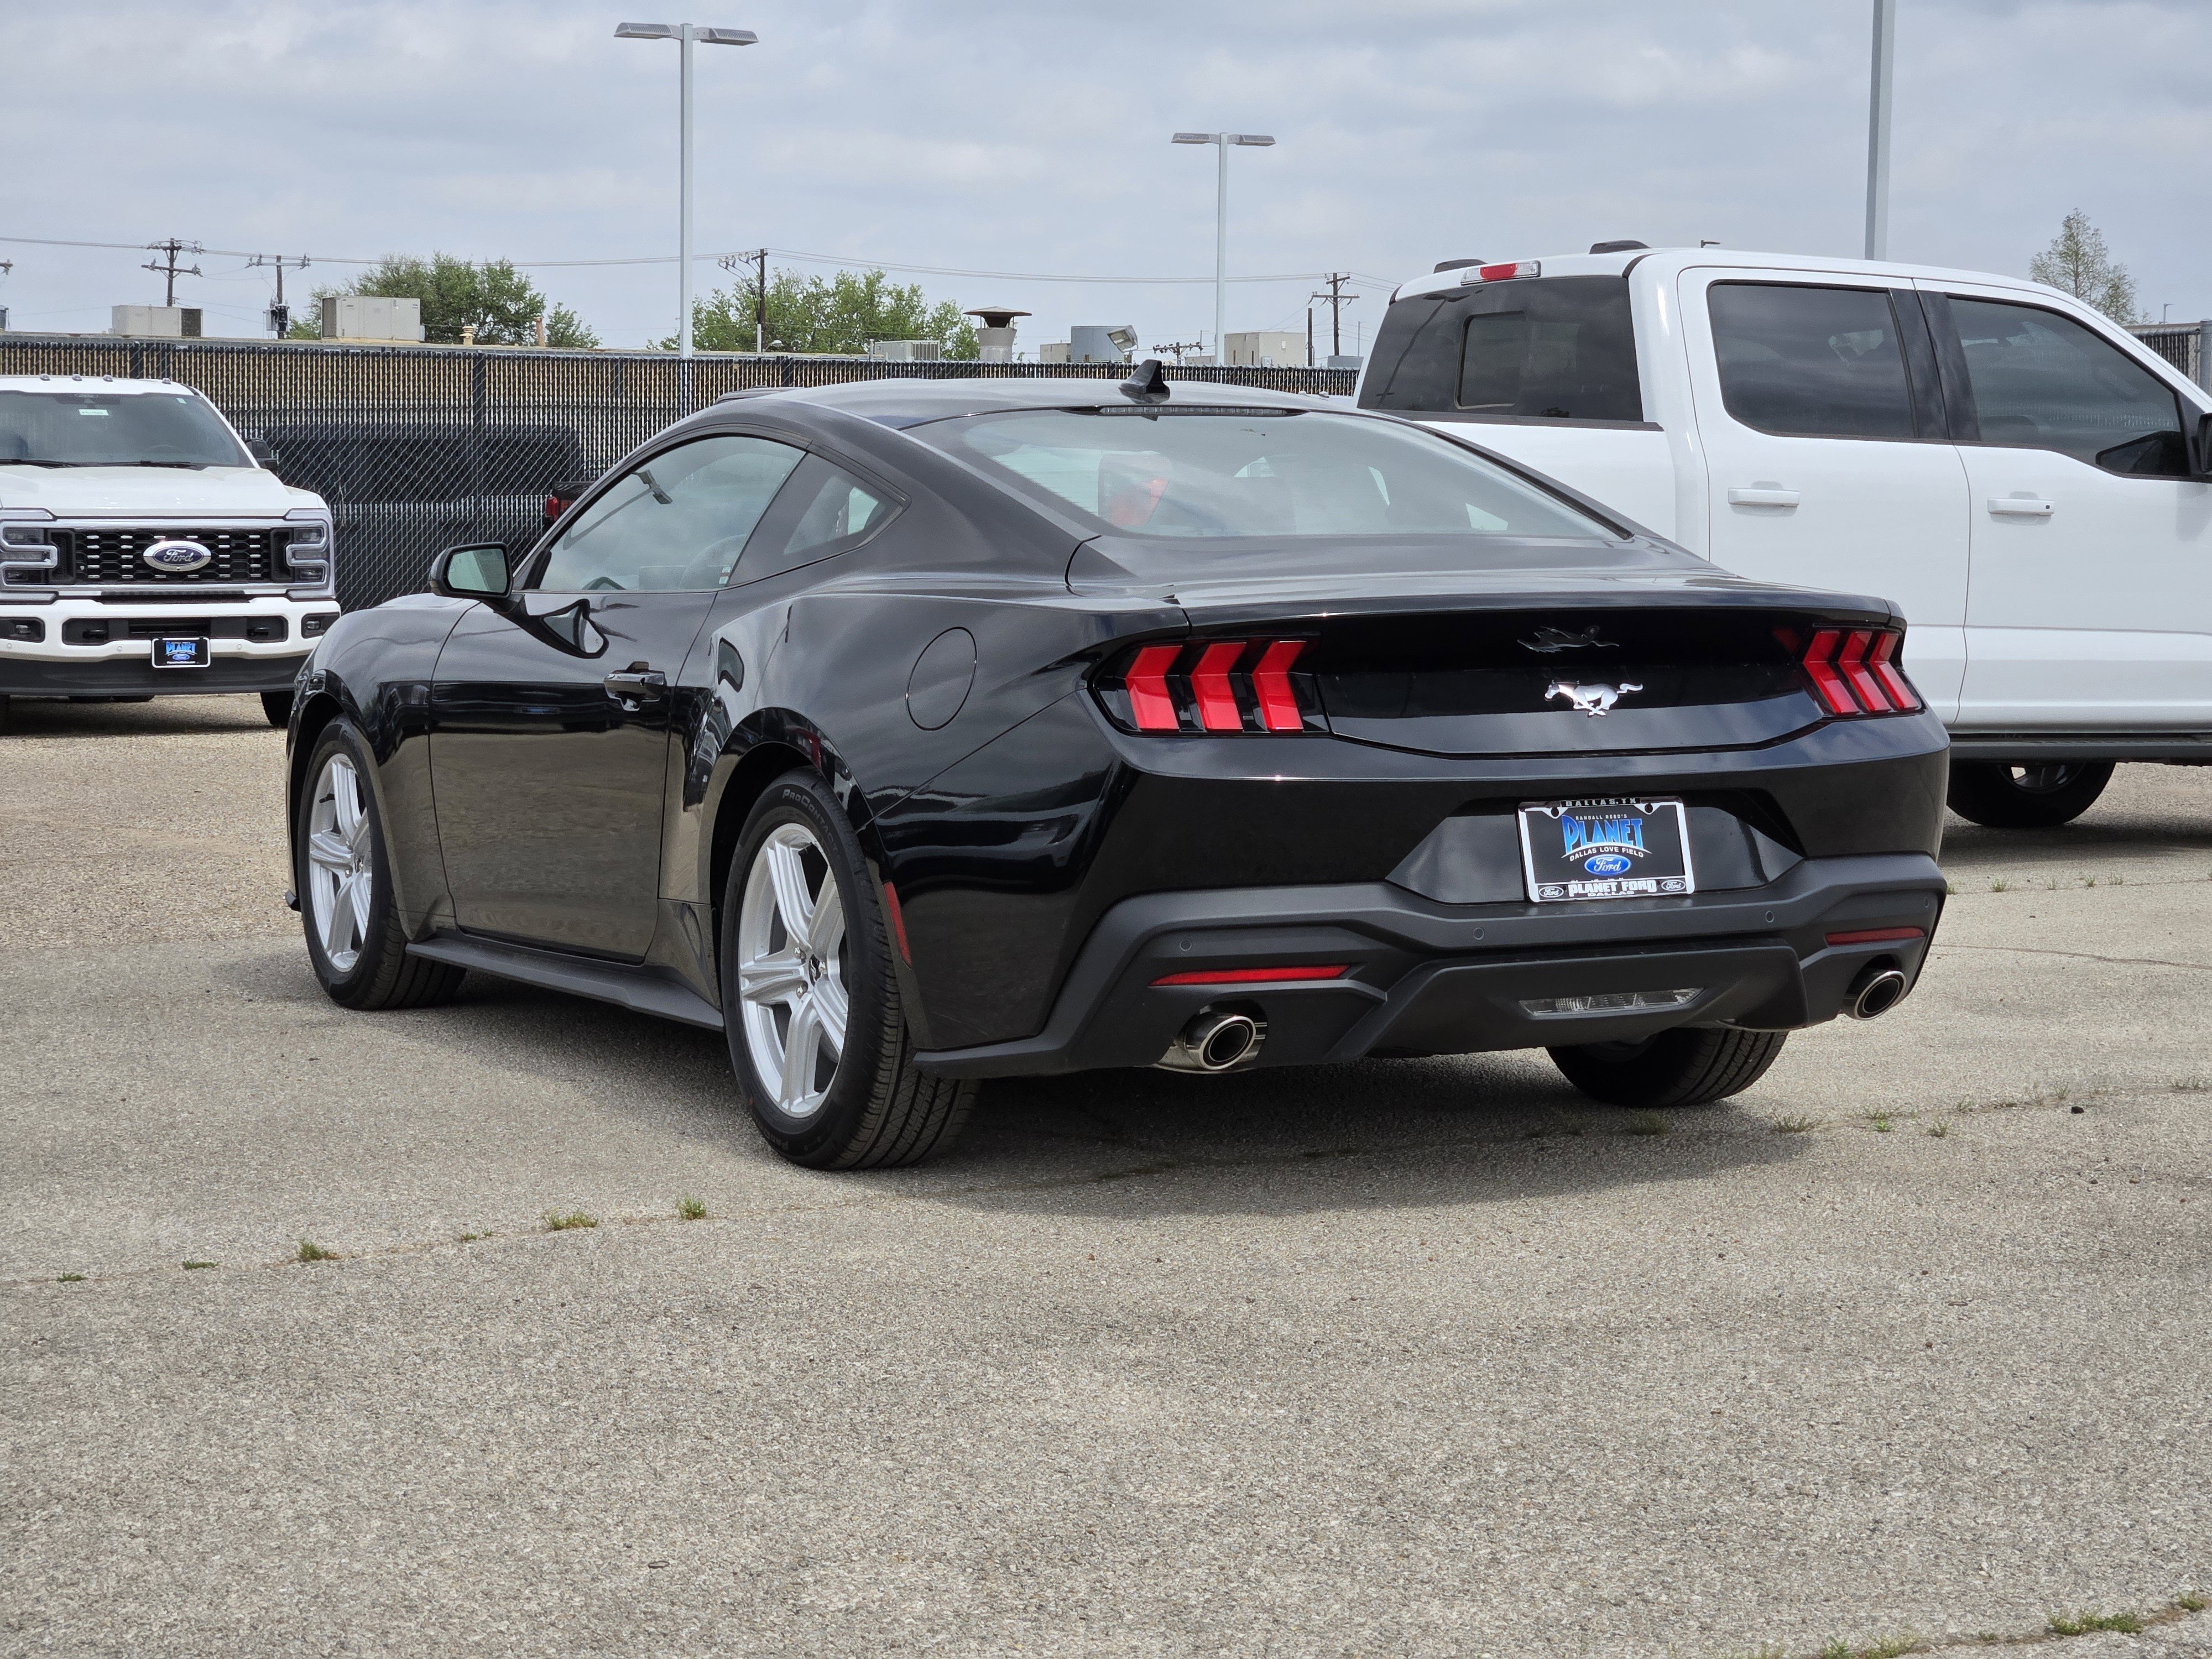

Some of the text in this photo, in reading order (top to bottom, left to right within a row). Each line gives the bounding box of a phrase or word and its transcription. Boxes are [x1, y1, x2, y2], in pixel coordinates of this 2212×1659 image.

[163, 549, 194, 562] Ford
[1561, 815, 1643, 854] PLANET
[1569, 848, 1597, 862] DALLAS
[1621, 847, 1644, 858] FIELD
[1594, 858, 1621, 872] Ford
[1568, 881, 1618, 897] PLANET
[1621, 879, 1657, 893] FORD
